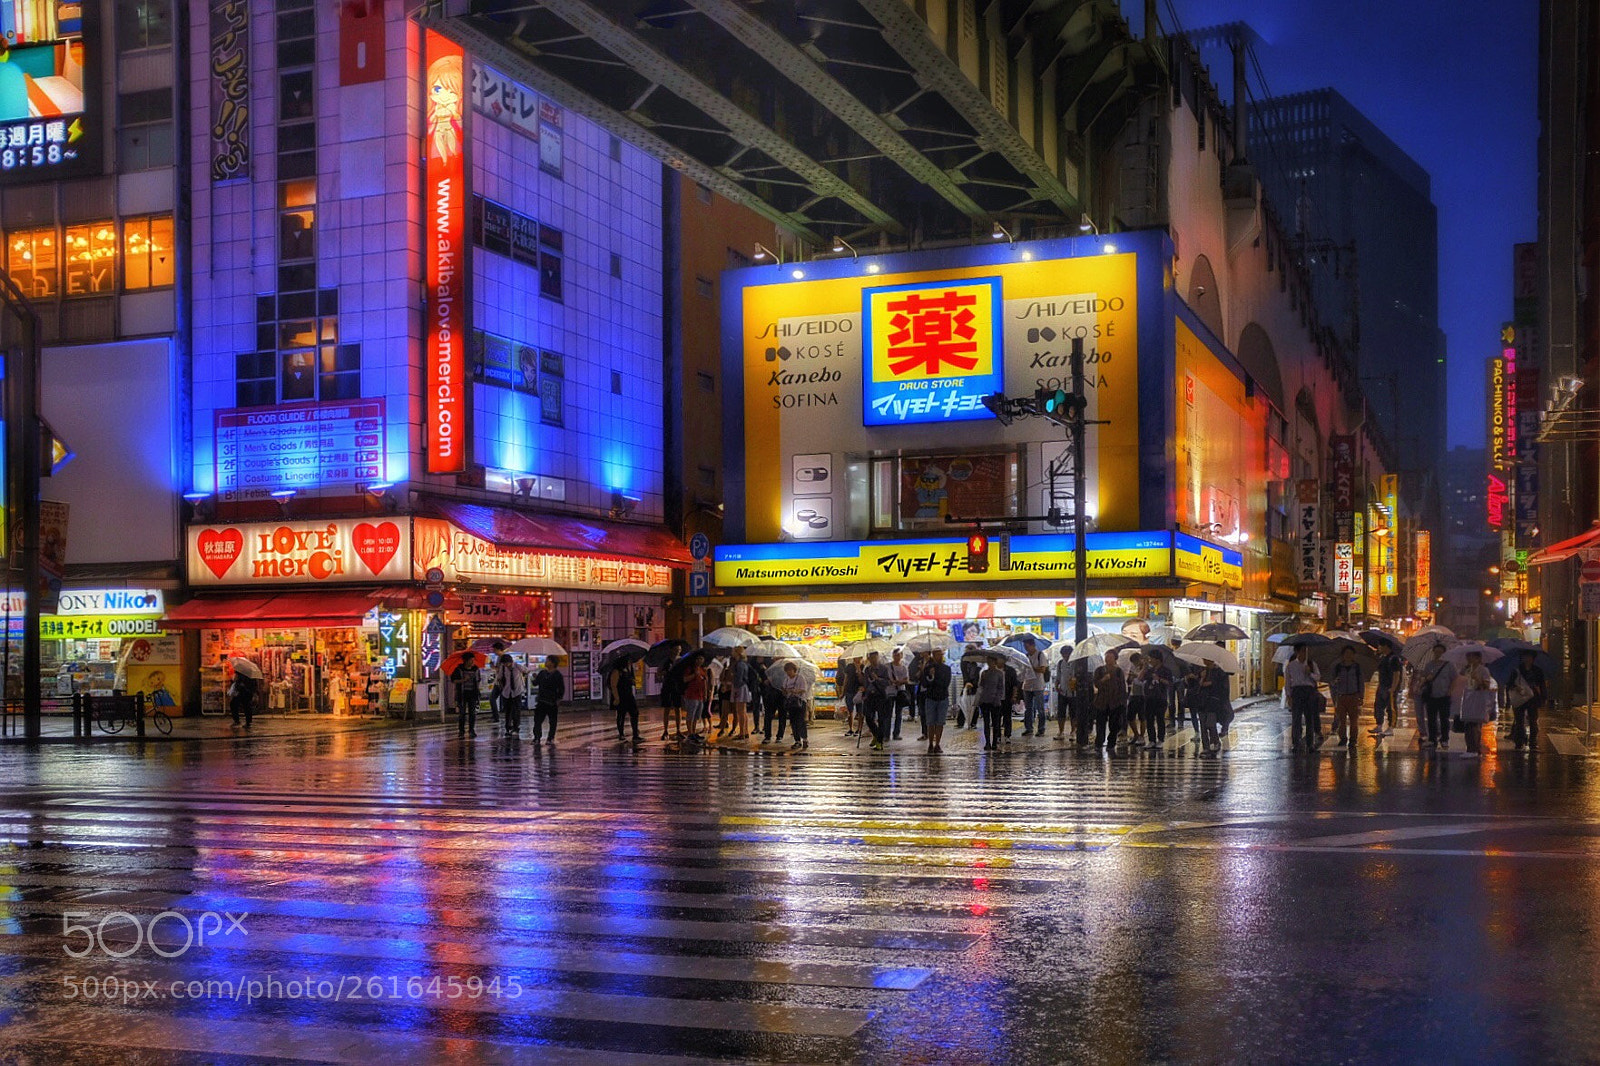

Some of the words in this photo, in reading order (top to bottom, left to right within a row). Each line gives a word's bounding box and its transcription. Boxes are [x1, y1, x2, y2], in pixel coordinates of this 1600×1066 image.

[437, 178, 453, 457] www.akibalovemerci.com
[1015, 297, 1124, 320] SHISEIDO
[755, 318, 853, 340] SHISEIDO
[887, 291, 979, 376] 薬
[1062, 320, 1115, 341] KOSÉ
[796, 341, 844, 360] KOSÉ
[1029, 348, 1112, 369] Kanbo
[767, 366, 842, 387] Kanebo
[899, 381, 928, 391] DRUG
[930, 378, 965, 389] STORE
[1036, 374, 1108, 391] SOFNA
[773, 392, 839, 410] SOFINA
[1493, 358, 1503, 425] PACHINKO
[247, 414, 276, 425] FLOOR
[279, 412, 305, 422] GUIDE
[269, 442, 297, 451] Goods
[224, 459, 236, 470] 2F
[283, 455, 311, 466] Goods
[224, 475, 236, 485] 1F
[244, 473, 283, 483] Costume
[284, 470, 319, 482] Lingerie
[1338, 473, 1350, 506] KFC
[204, 540, 236, 554] 秋葉原
[258, 526, 334, 554] LOVE
[735, 567, 808, 579] Matsumoto
[810, 565, 858, 577] KiYoshi
[1010, 559, 1091, 572] Matsumoo
[1094, 557, 1147, 570] KiYoshi
[1339, 560, 1350, 592] お弁当
[66, 621, 103, 635] オーディオ
